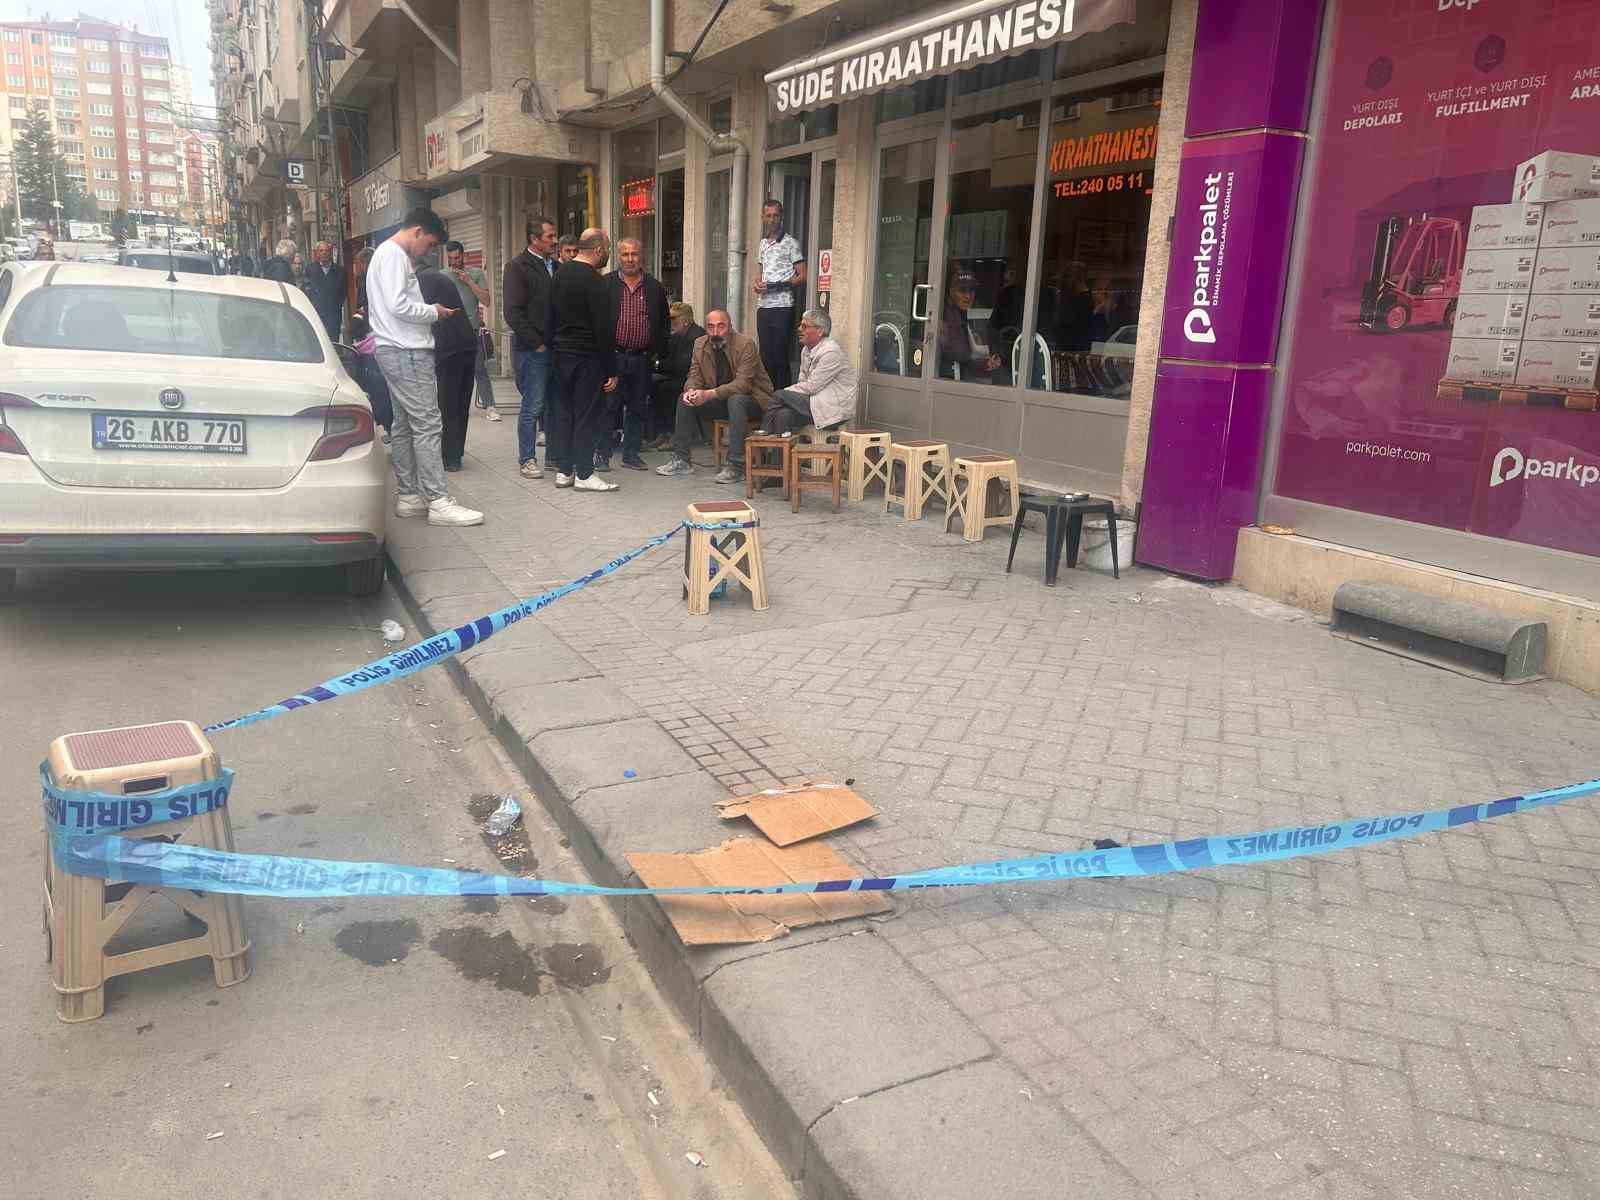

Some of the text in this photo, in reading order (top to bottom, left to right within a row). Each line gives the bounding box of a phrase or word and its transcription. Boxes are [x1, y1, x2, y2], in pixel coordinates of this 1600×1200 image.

[776, 68, 834, 112] SUDE
[1427, 89, 1454, 102] YURT
[1475, 86, 1488, 96] ve
[1490, 79, 1517, 93] YURT
[1352, 100, 1375, 113] YURT
[1435, 94, 1531, 118] FULFILLMENT
[1343, 112, 1404, 131] DEPOLARI
[1054, 172, 1143, 198] TEL:240 05 11
[1193, 171, 1223, 307] parkpalet
[1217, 222, 1228, 266] DEPOLAMA
[108, 418, 135, 440] 26
[150, 420, 189, 442] AKB
[203, 421, 242, 444] 770
[1346, 440, 1431, 464] parkpalet.com
[341, 665, 391, 687] POLİS
